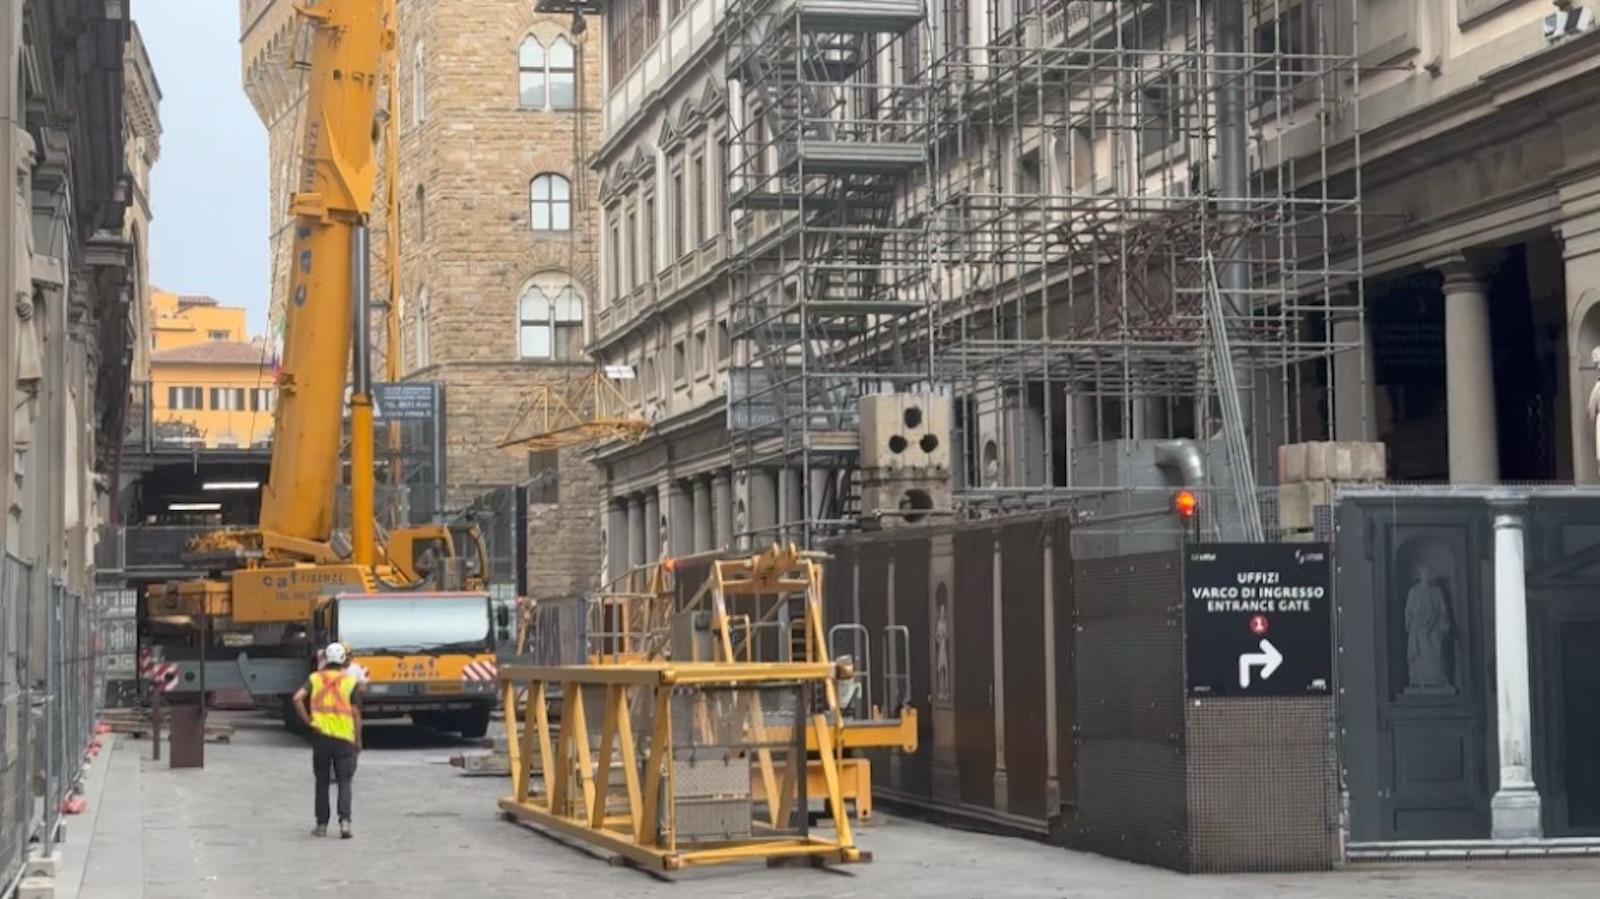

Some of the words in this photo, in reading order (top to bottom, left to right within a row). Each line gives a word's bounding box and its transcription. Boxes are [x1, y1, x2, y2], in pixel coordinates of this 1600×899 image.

[263, 571, 297, 588] caf
[301, 572, 347, 585] FIRENZE
[1237, 572, 1280, 584] UFFIZI
[1192, 587, 1238, 599] VARCO
[1241, 587, 1256, 598] DI
[1259, 586, 1325, 599] INGRESSO
[1207, 600, 1275, 612] ENTRANCE
[1278, 600, 1311, 612] GATE
[397, 658, 435, 672] caf
